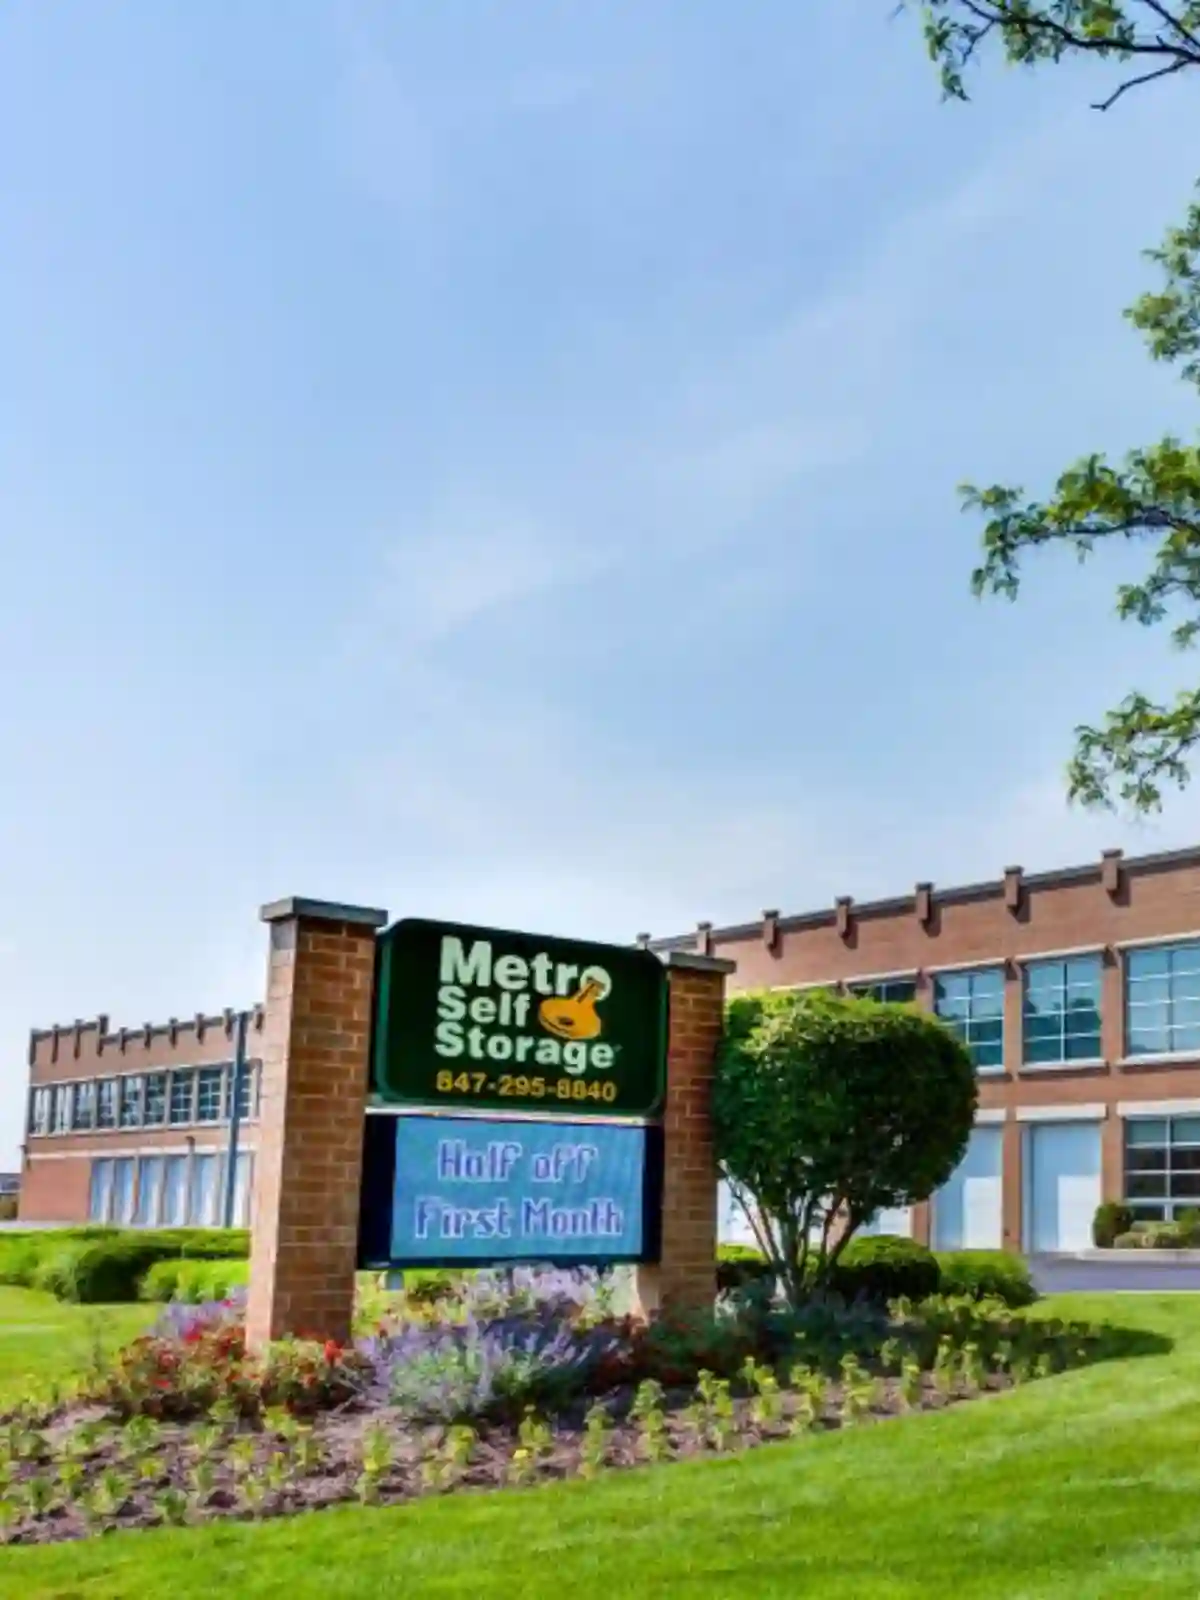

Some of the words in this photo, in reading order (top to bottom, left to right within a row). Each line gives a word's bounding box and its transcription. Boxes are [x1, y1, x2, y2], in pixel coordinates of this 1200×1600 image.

[440, 936, 611, 1000] Metro
[437, 986, 530, 1026] Self
[435, 1022, 615, 1074] Storage
[439, 1140, 523, 1182] Half
[533, 1144, 598, 1183] off
[416, 1198, 511, 1239] First
[523, 1198, 622, 1237] Month
